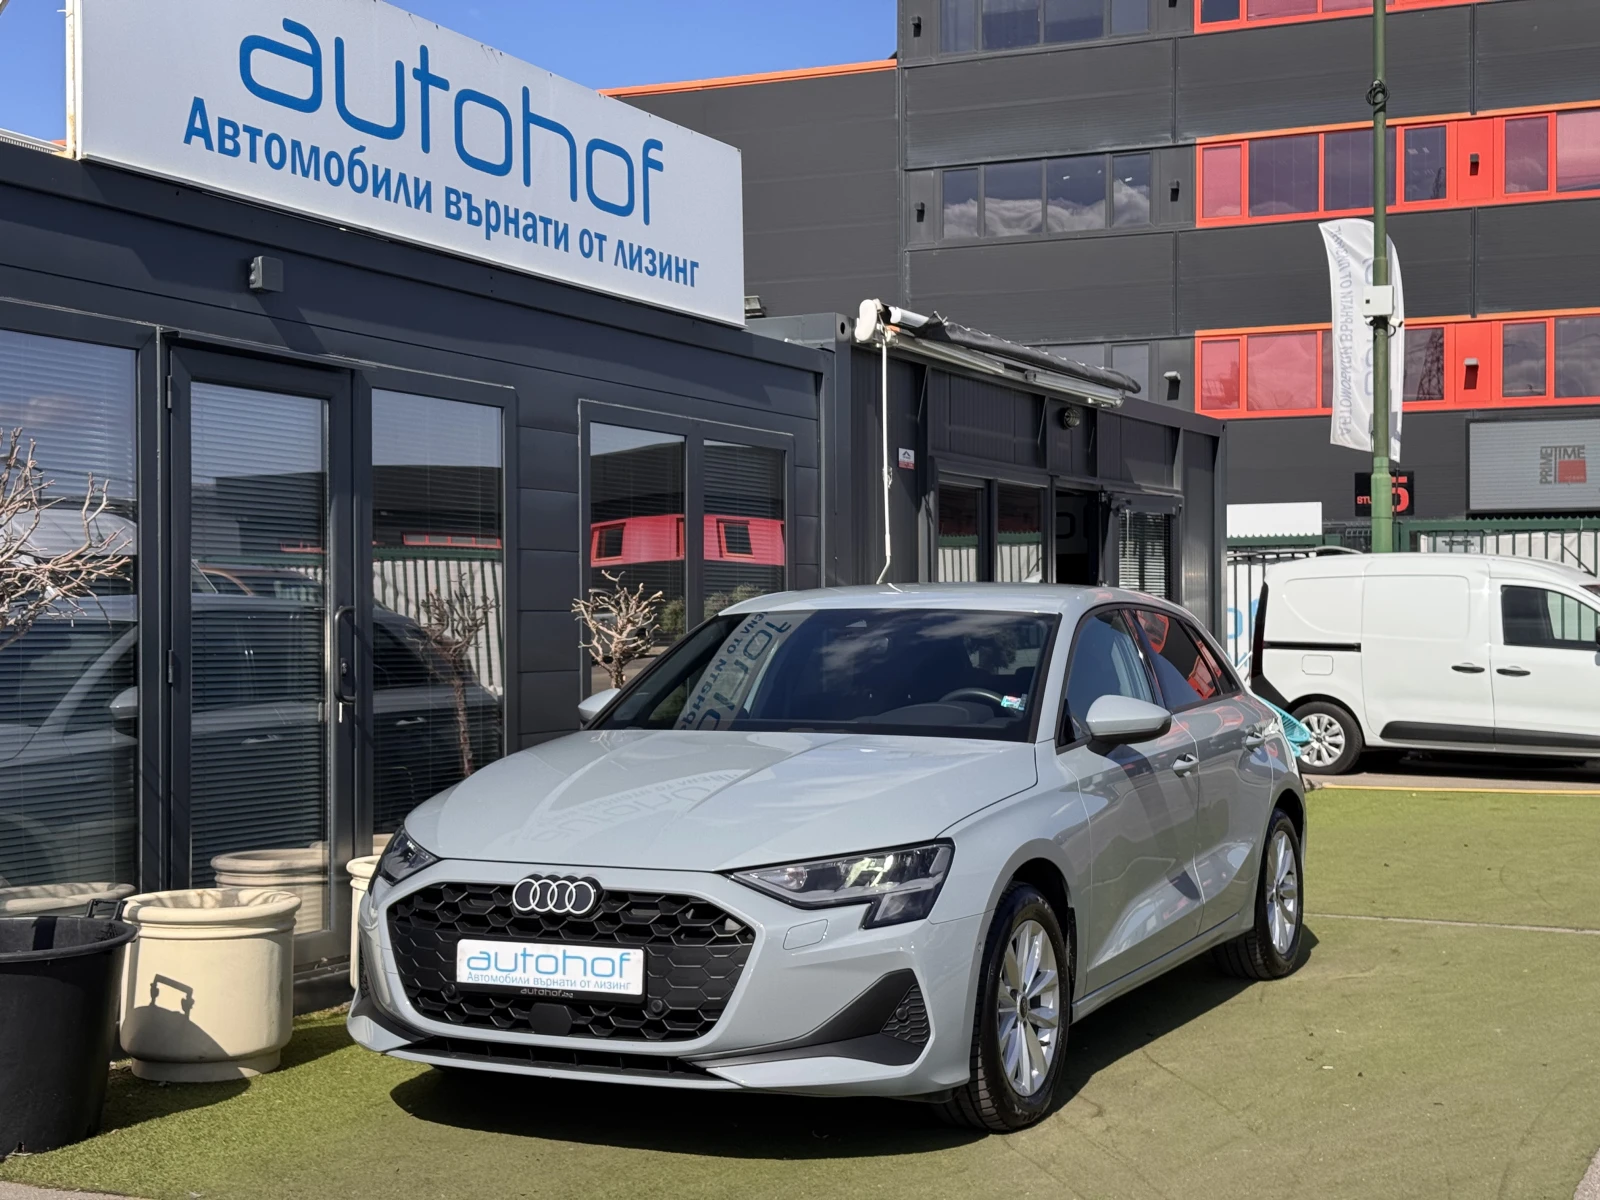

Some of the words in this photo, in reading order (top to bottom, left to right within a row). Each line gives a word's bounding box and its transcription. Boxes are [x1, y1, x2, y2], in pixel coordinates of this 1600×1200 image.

[239, 18, 664, 225] autohof
[184, 96, 432, 213] Автомобили
[445, 186, 569, 252] върнати
[579, 228, 607, 261] от
[613, 240, 700, 288] лизинг
[466, 947, 631, 979] autohof
[467, 971, 530, 985] Автомобили
[533, 977, 577, 988] върнати
[580, 979, 592, 989] от
[593, 980, 632, 991] лизинг
